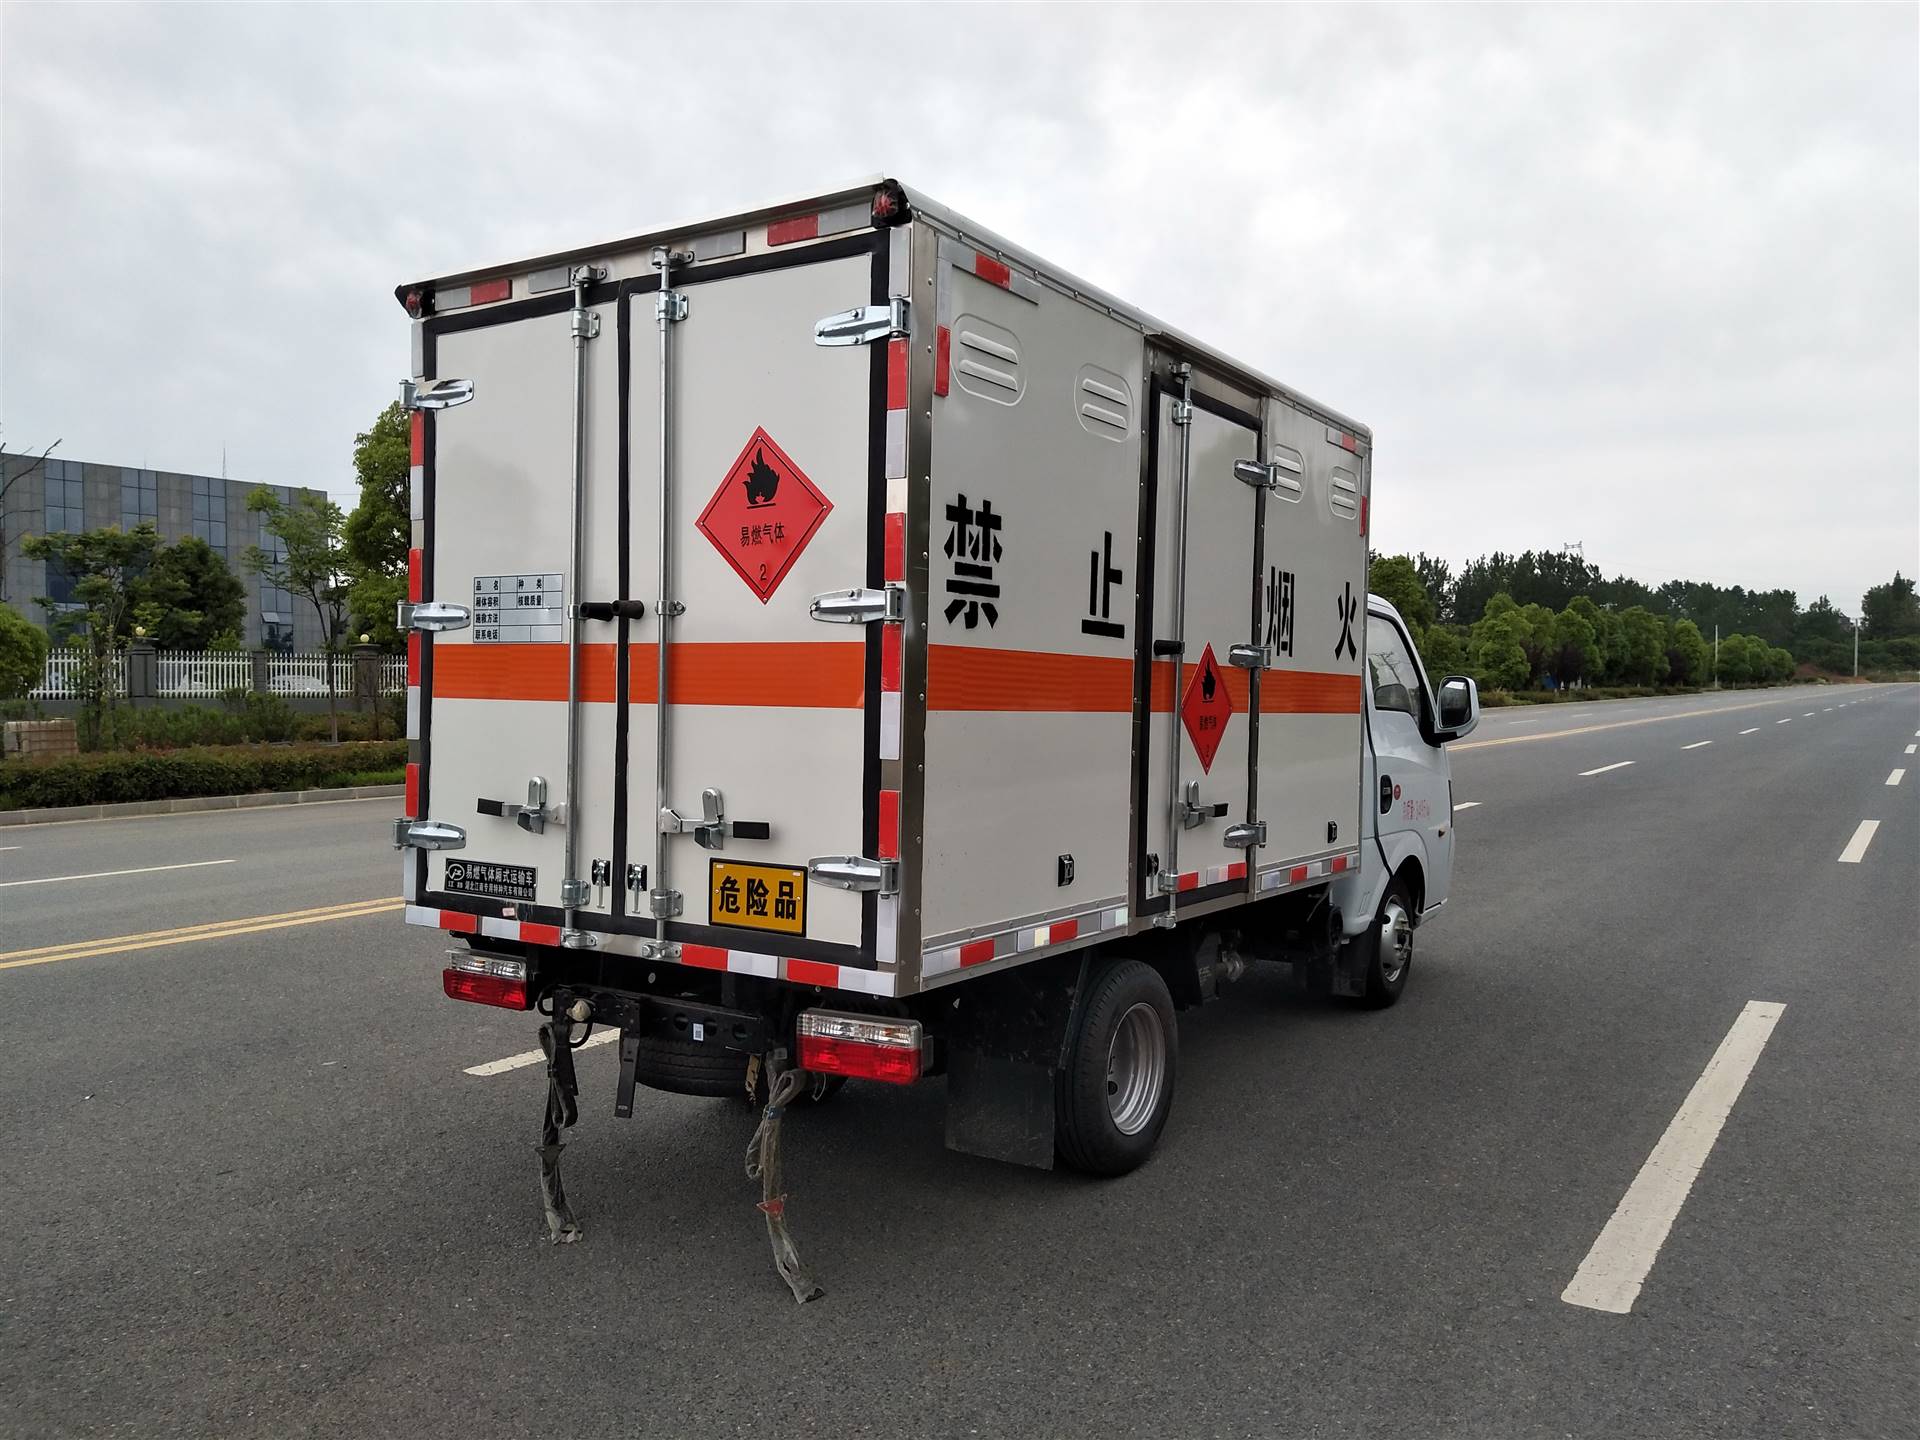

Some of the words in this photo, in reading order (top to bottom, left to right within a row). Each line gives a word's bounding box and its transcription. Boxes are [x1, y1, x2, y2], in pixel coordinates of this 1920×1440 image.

[739, 522, 785, 547] 易燃气体
[759, 563, 767, 581] 2
[475, 629, 498, 640] 联系电话
[465, 864, 533, 886] 易燃气体厢式运输车
[718, 875, 797, 920] 危险品
